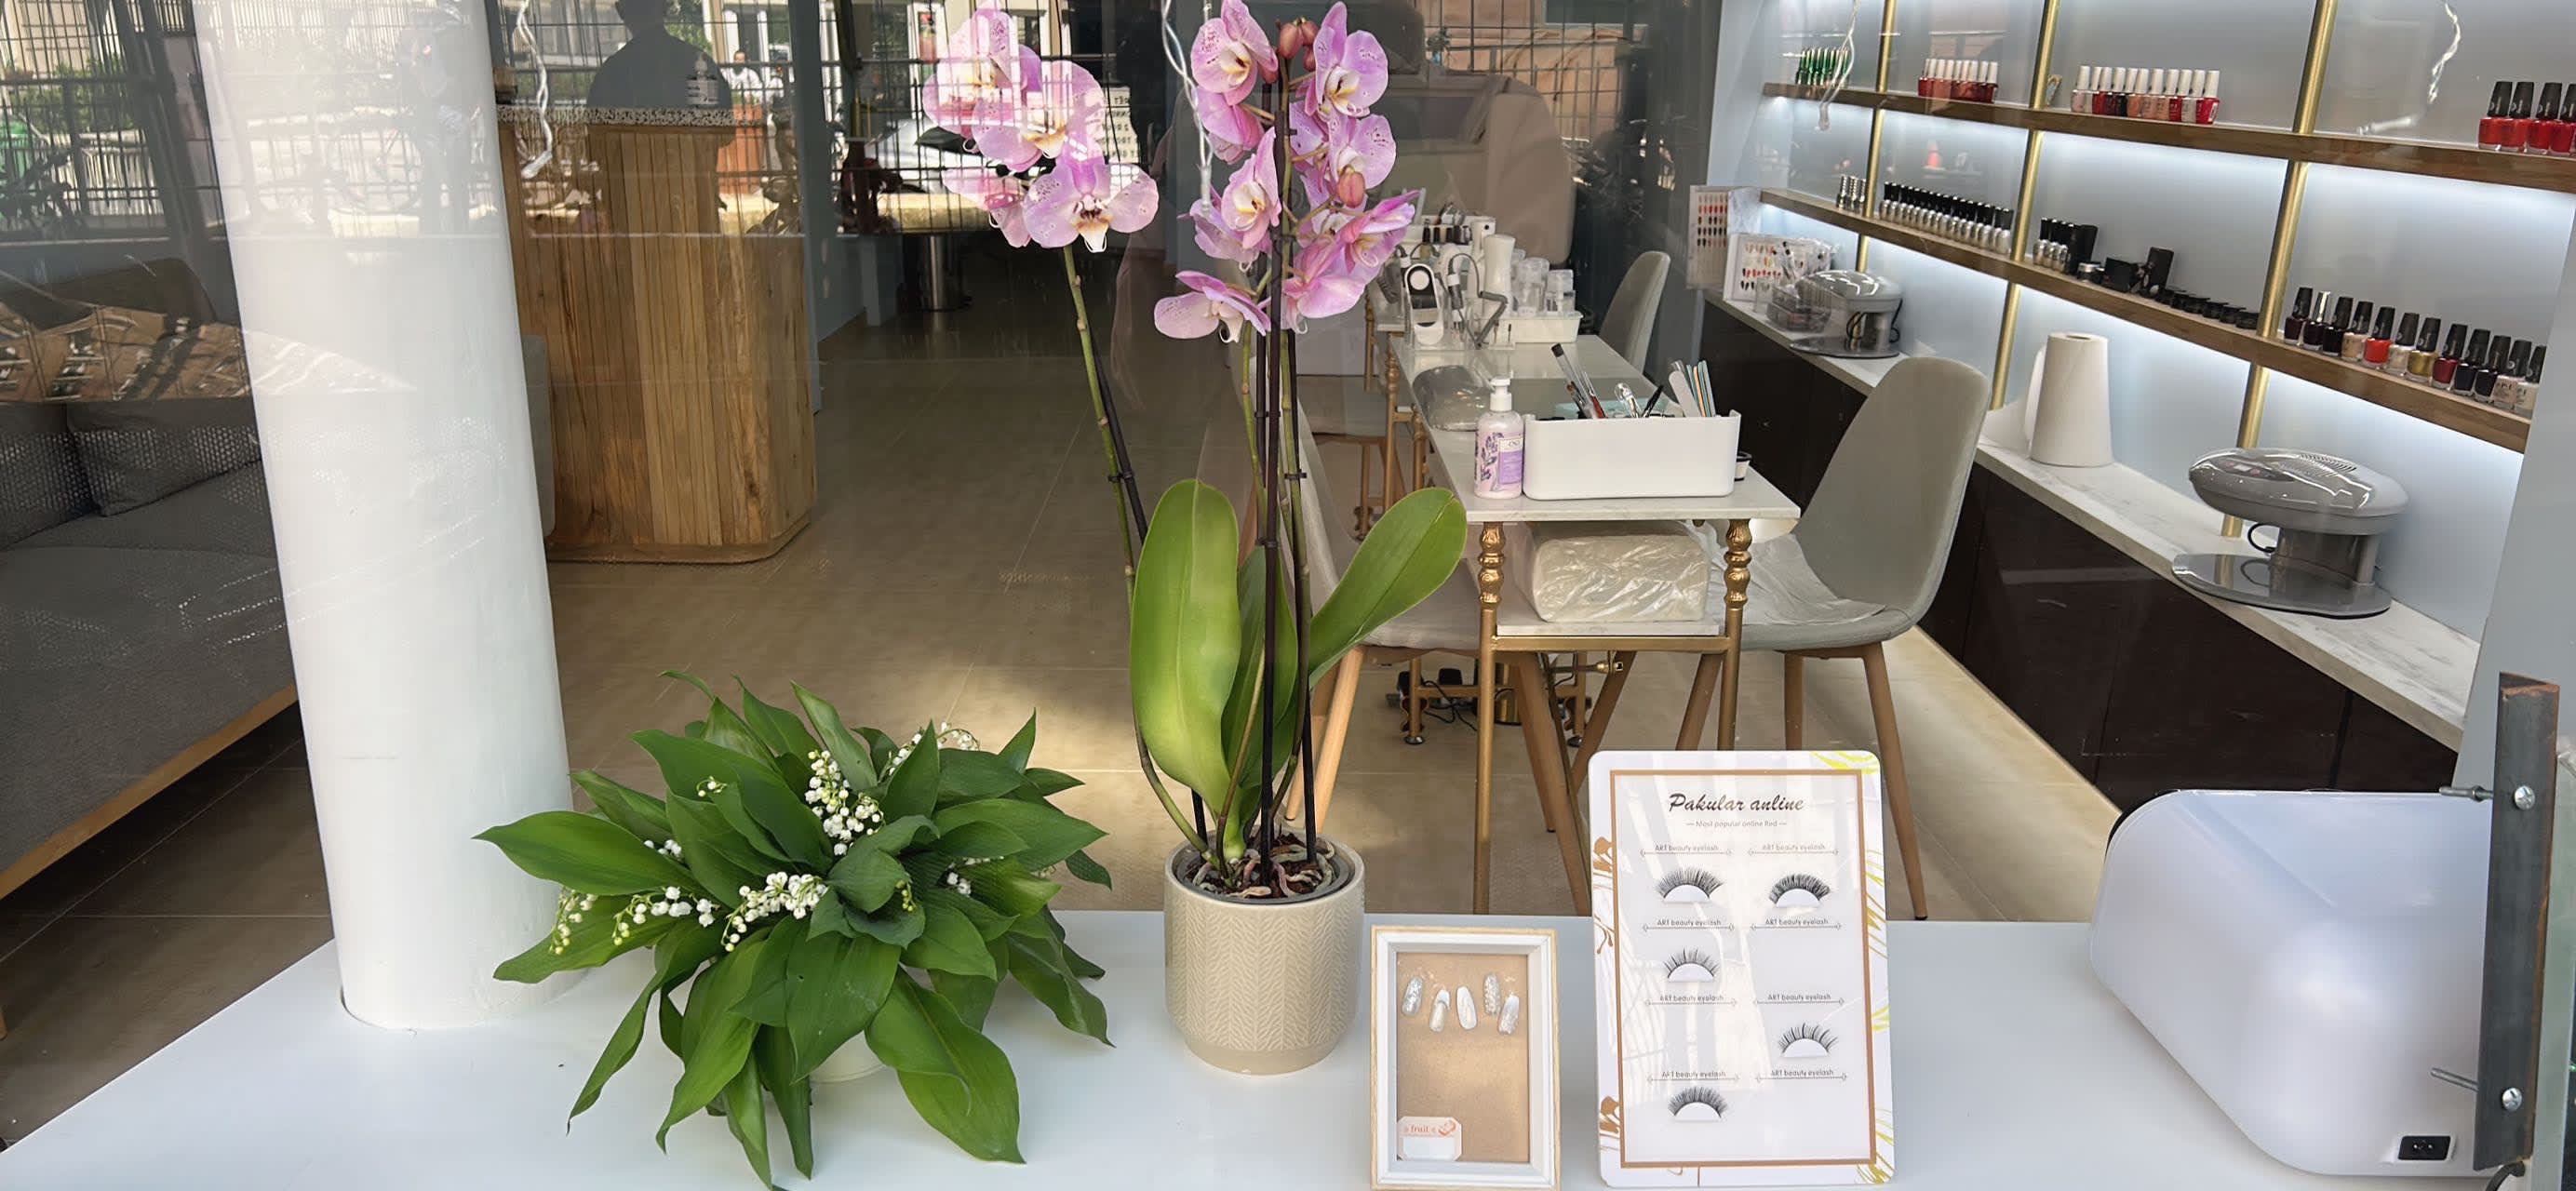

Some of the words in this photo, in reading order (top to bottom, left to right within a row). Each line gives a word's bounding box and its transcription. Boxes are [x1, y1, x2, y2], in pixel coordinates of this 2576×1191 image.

[1781, 994, 1804, 1002] beauty
[1805, 994, 1831, 1002] eyelash
[1783, 1069, 1806, 1077] beauty
[1807, 1069, 1834, 1077] eyelash
